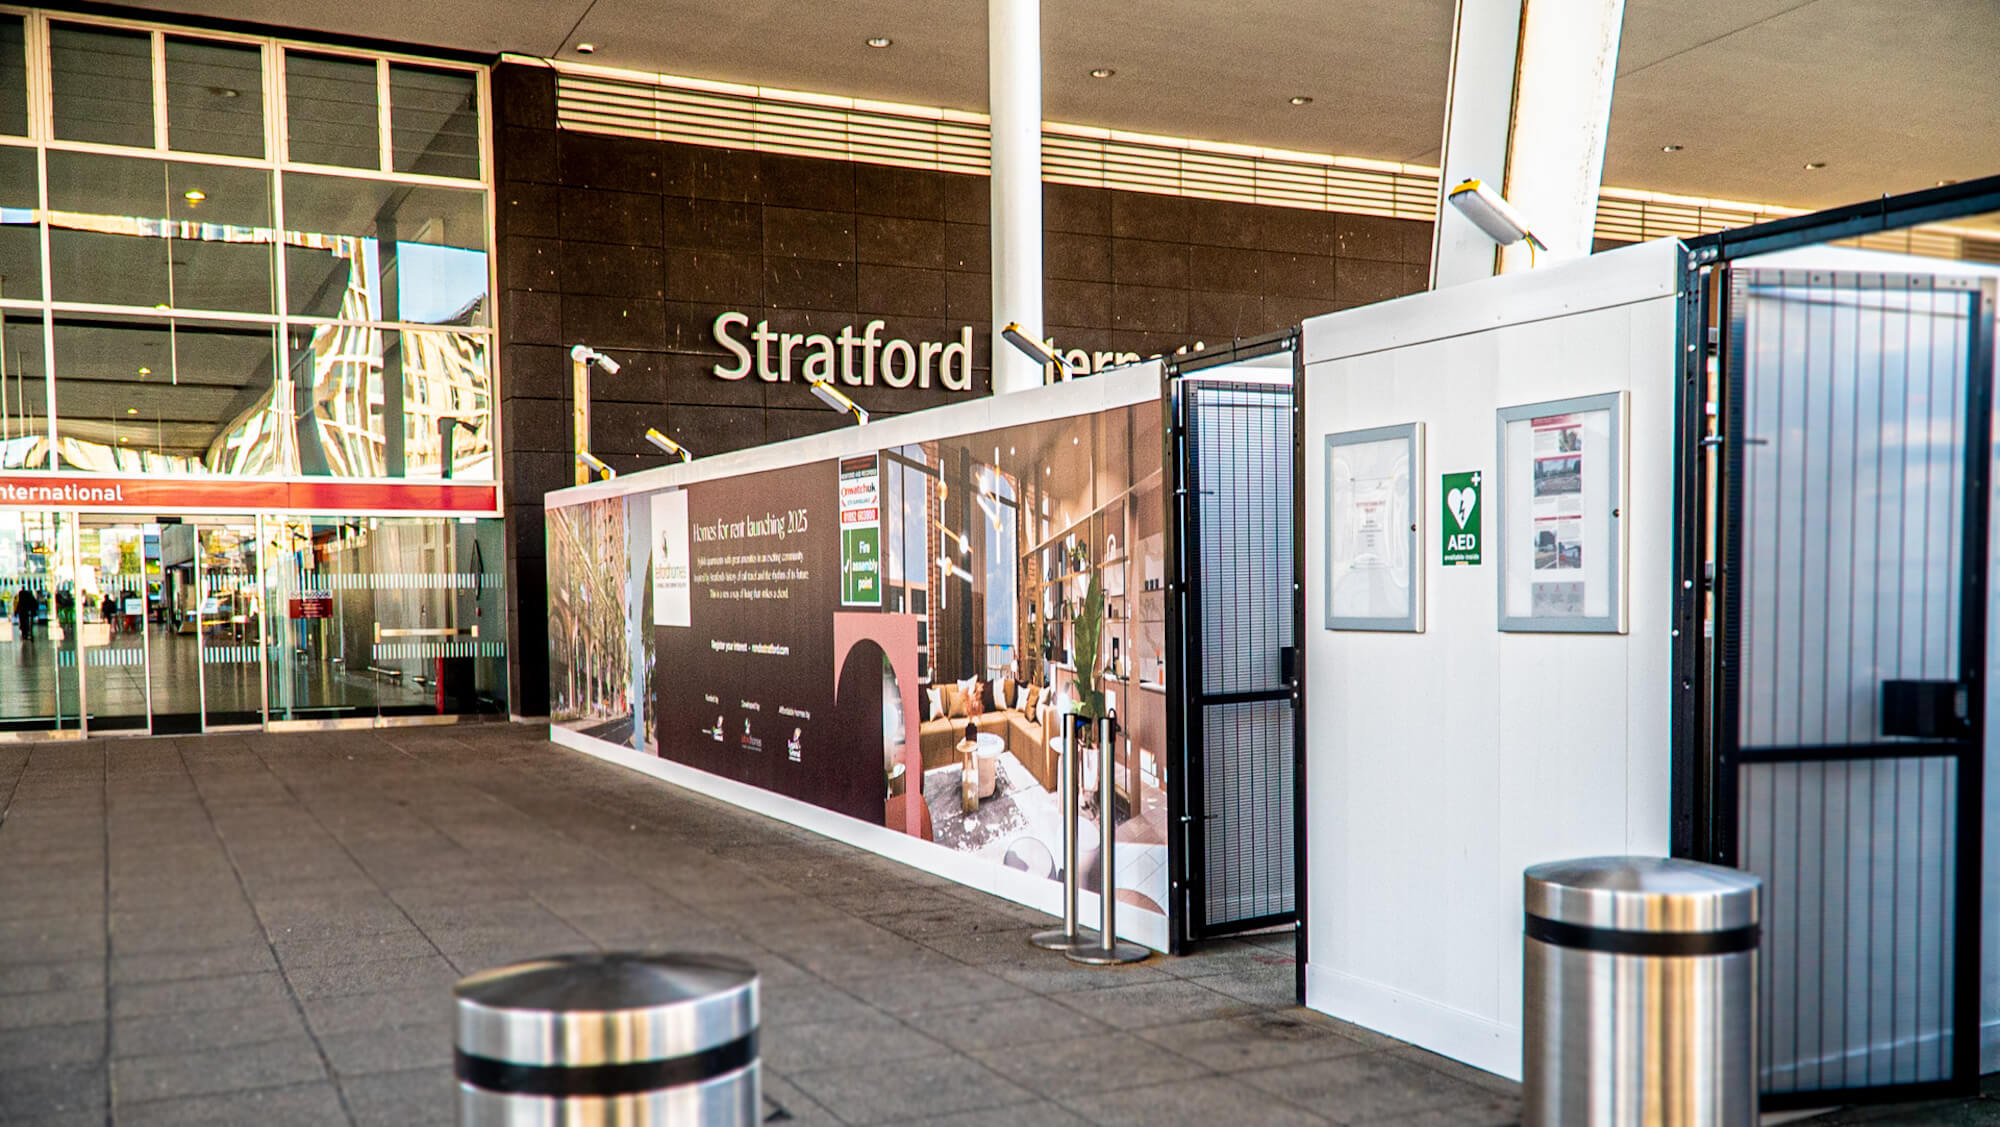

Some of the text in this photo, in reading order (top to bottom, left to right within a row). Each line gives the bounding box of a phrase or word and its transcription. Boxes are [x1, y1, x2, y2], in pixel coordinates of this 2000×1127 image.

[711, 310, 974, 392] Stratford
[693, 508, 808, 543] Homes for rent launching 2025
[1447, 534, 1476, 551] AED
[852, 558, 878, 574] assembly
[858, 576, 873, 592] point
